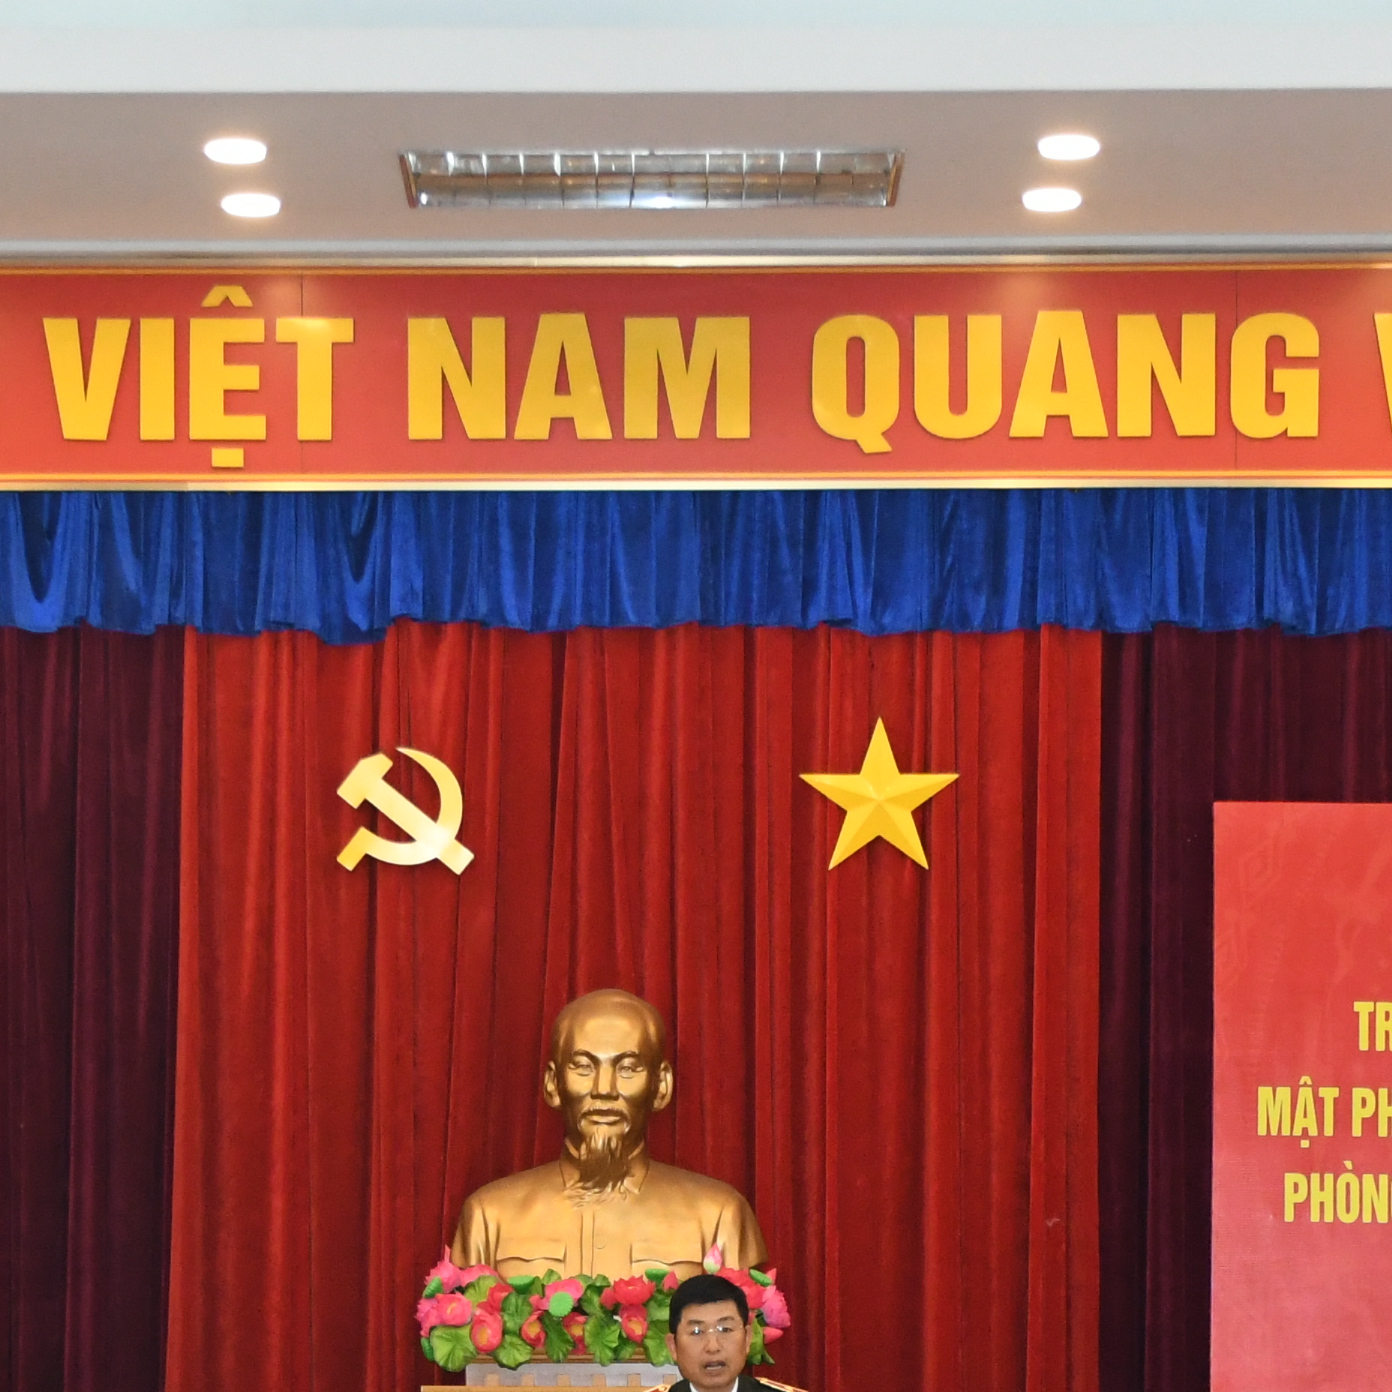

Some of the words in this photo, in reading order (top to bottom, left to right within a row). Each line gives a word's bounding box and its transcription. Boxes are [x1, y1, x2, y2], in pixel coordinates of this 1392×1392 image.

[43, 284, 355, 468] VIỆT
[407, 311, 752, 441] NAM
[811, 309, 1320, 454] QUANG
[1257, 1075, 1340, 1149] MẬT
